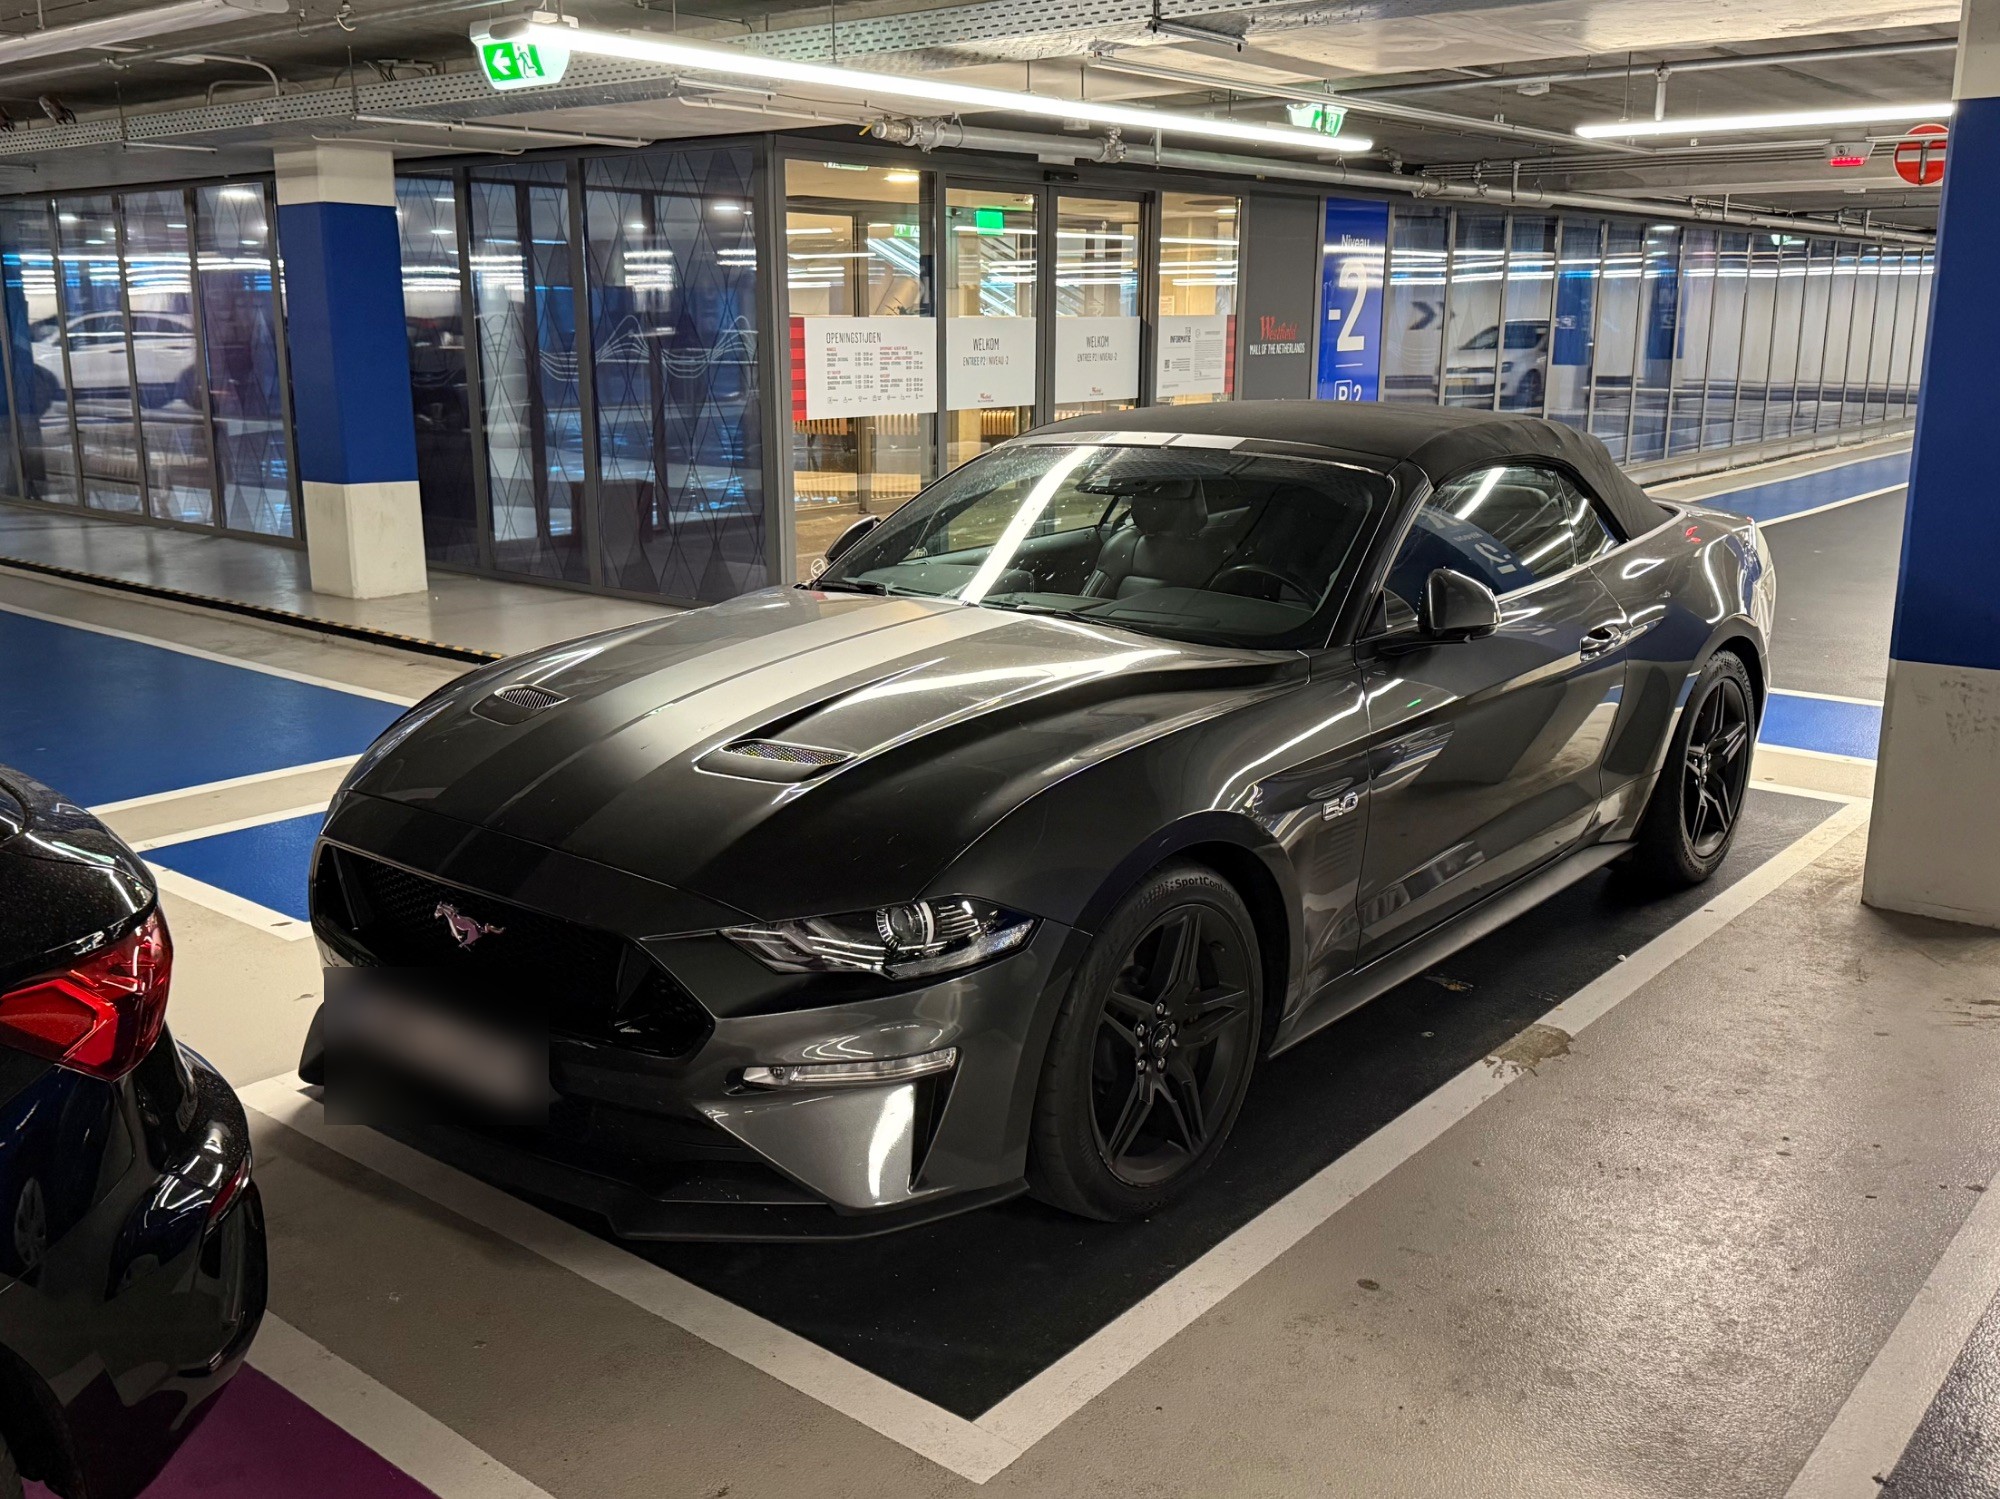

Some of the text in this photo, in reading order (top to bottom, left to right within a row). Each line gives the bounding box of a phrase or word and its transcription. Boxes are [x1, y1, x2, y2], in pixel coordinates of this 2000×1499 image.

[1341, 234, 1370, 248] Niveau
[826, 332, 882, 344] OPENINGSTIJDEN
[1086, 336, 1110, 348] WELKOM
[973, 338, 1000, 351] WELKOM
[1250, 343, 1306, 355] MALL OF THE NETHERLANDS
[1322, 791, 1359, 821] 5.0
